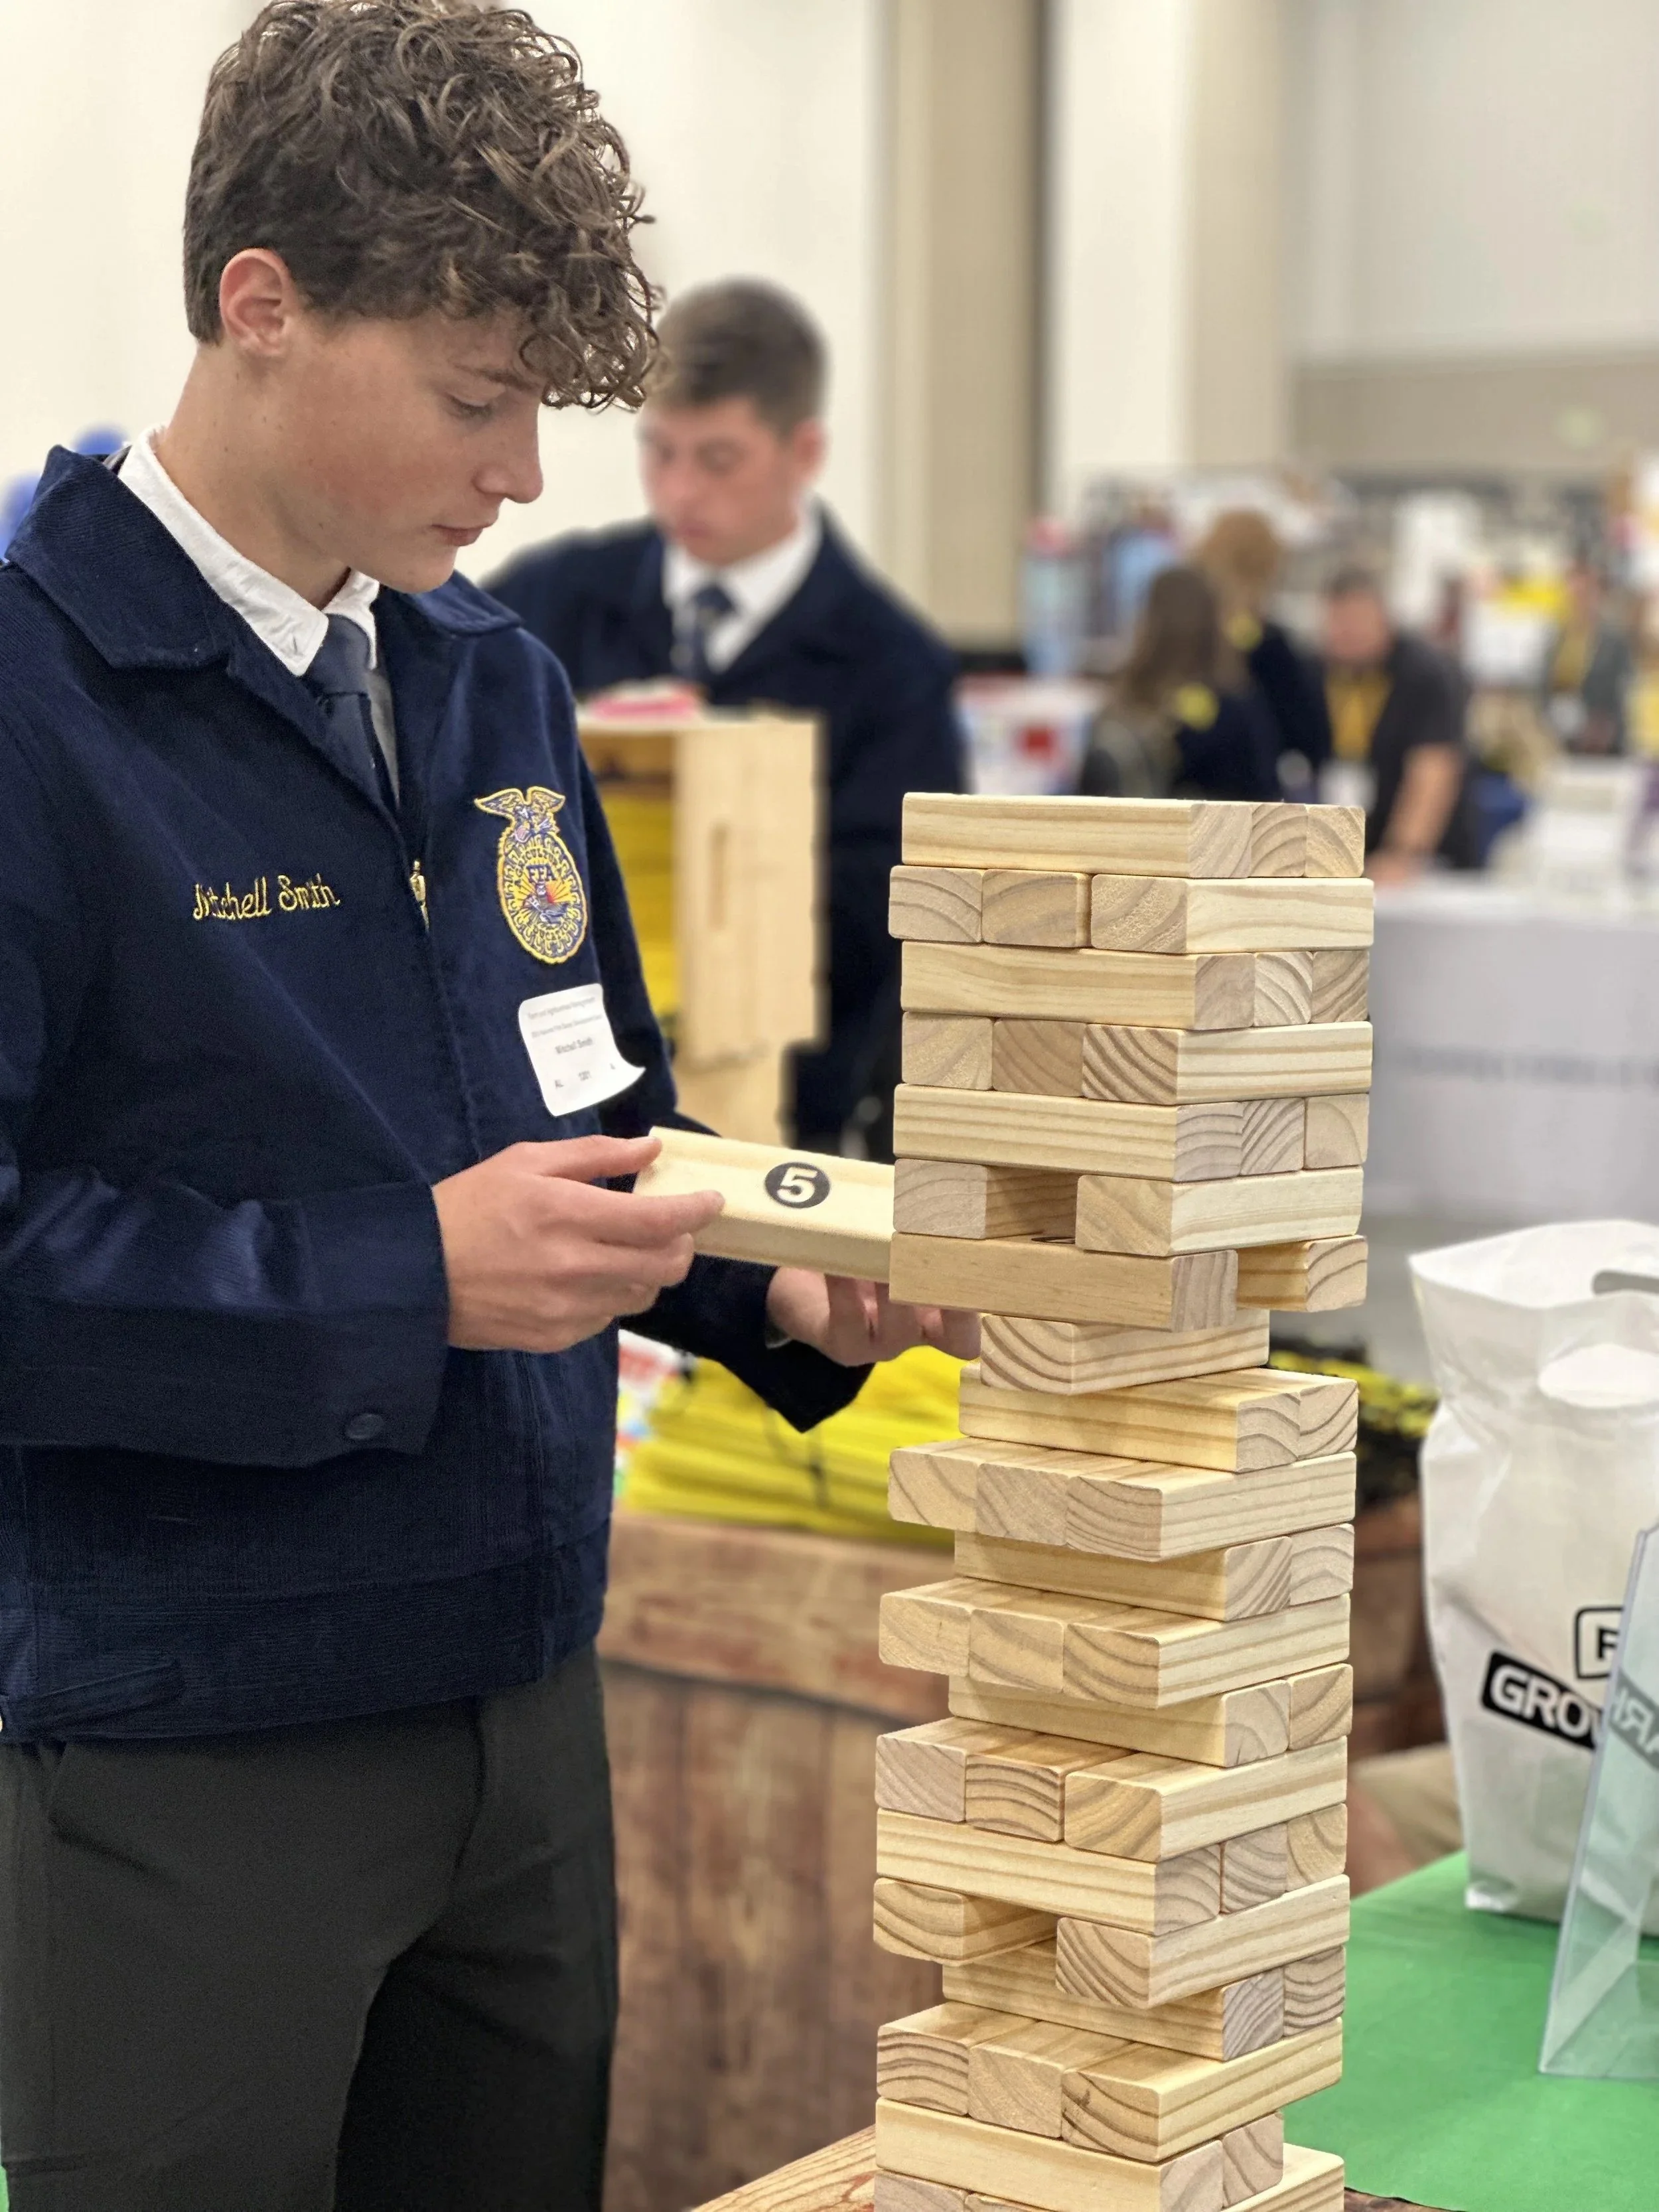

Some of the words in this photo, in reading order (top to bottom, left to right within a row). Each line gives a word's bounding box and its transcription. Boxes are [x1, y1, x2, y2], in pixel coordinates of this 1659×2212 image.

[526, 864, 556, 883] FFA
[776, 1166, 818, 1203] 5
[1490, 1664, 1601, 1737] GRO
